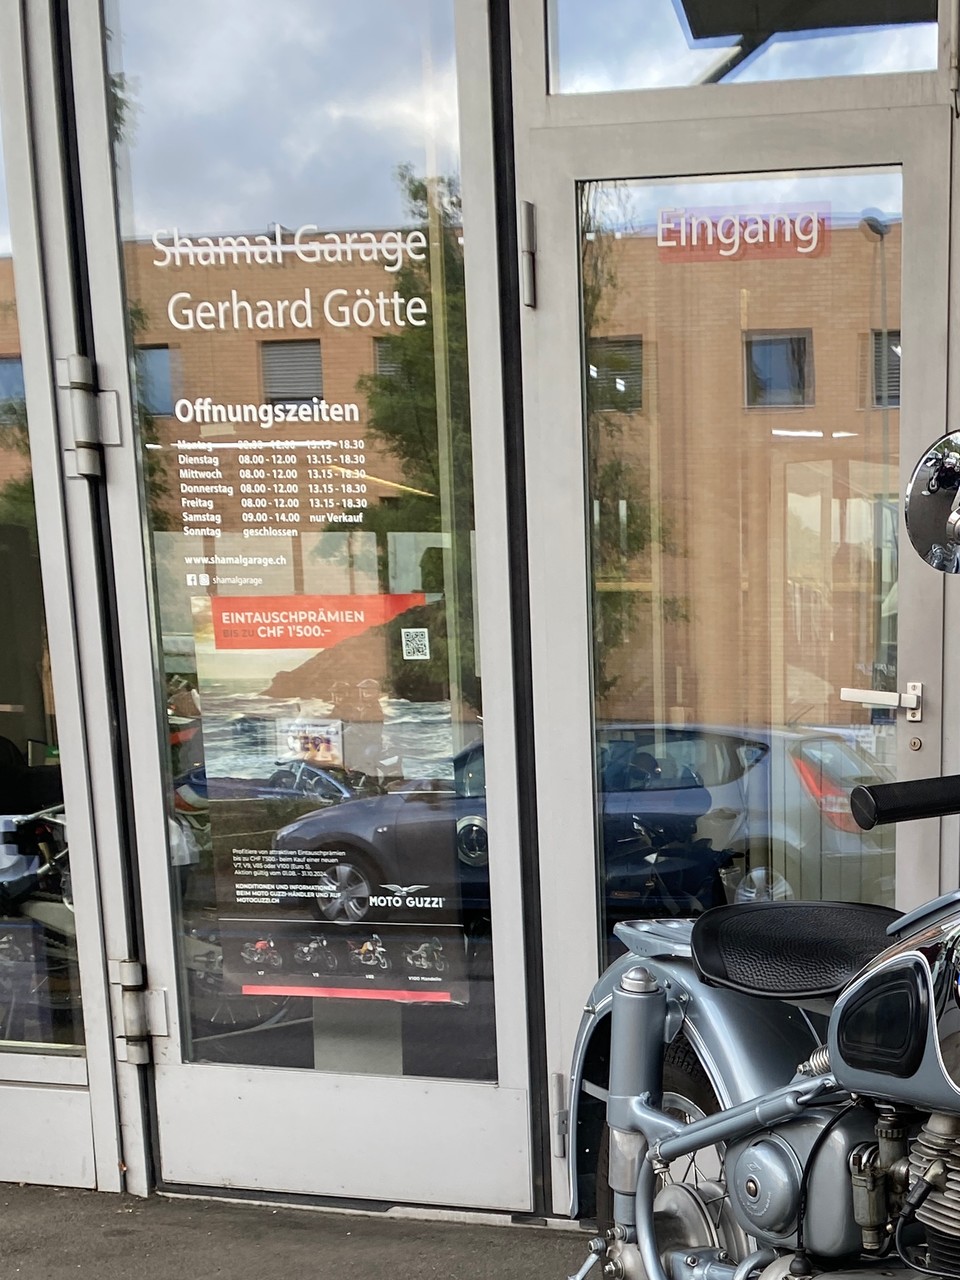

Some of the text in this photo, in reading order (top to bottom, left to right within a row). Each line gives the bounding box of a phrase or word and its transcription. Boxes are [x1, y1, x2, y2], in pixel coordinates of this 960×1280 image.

[657, 207, 820, 256] Eingang
[151, 224, 427, 272] Shamal Garage
[167, 288, 427, 330] Gerhard Götte
[338, 440, 364, 449] 18.30
[178, 455, 219, 466] Dienstag
[238, 454, 264, 464] 08.00
[272, 454, 296, 464] 12.00
[306, 454, 332, 464] 13.15
[340, 454, 365, 464] 18.30
[179, 469, 222, 478] Mittwoch
[240, 469, 265, 478] 08.00
[272, 469, 297, 478] 12.00
[308, 469, 333, 478] 13.15
[340, 469, 366, 478] 18.30
[180, 484, 234, 496] Donnerstag
[240, 484, 266, 494] 08.00
[273, 484, 298, 494] 12.00
[308, 484, 334, 494] 13.15
[341, 484, 366, 494] 18.30
[181, 498, 214, 509] Freitag
[242, 498, 267, 508] 08.00
[274, 498, 299, 508] 12.00
[310, 498, 335, 508] 13.15
[342, 498, 368, 508] 18.30
[182, 512, 221, 524] Samstag
[242, 512, 268, 522] 09.00
[275, 512, 300, 522] 14.00
[326, 512, 363, 522] Verkauf
[184, 526, 298, 538] Sonntag geschlossen
[184, 554, 286, 566] www.shamalgarage.ch
[212, 576, 263, 586] shamalgarage
[221, 608, 365, 624] EINTAUSCHPRÄMIEN
[223, 629, 239, 638] BIS
[242, 629, 254, 638] ZU
[257, 626, 284, 638] CHF
[369, 896, 443, 908] MOTO GUZZI
